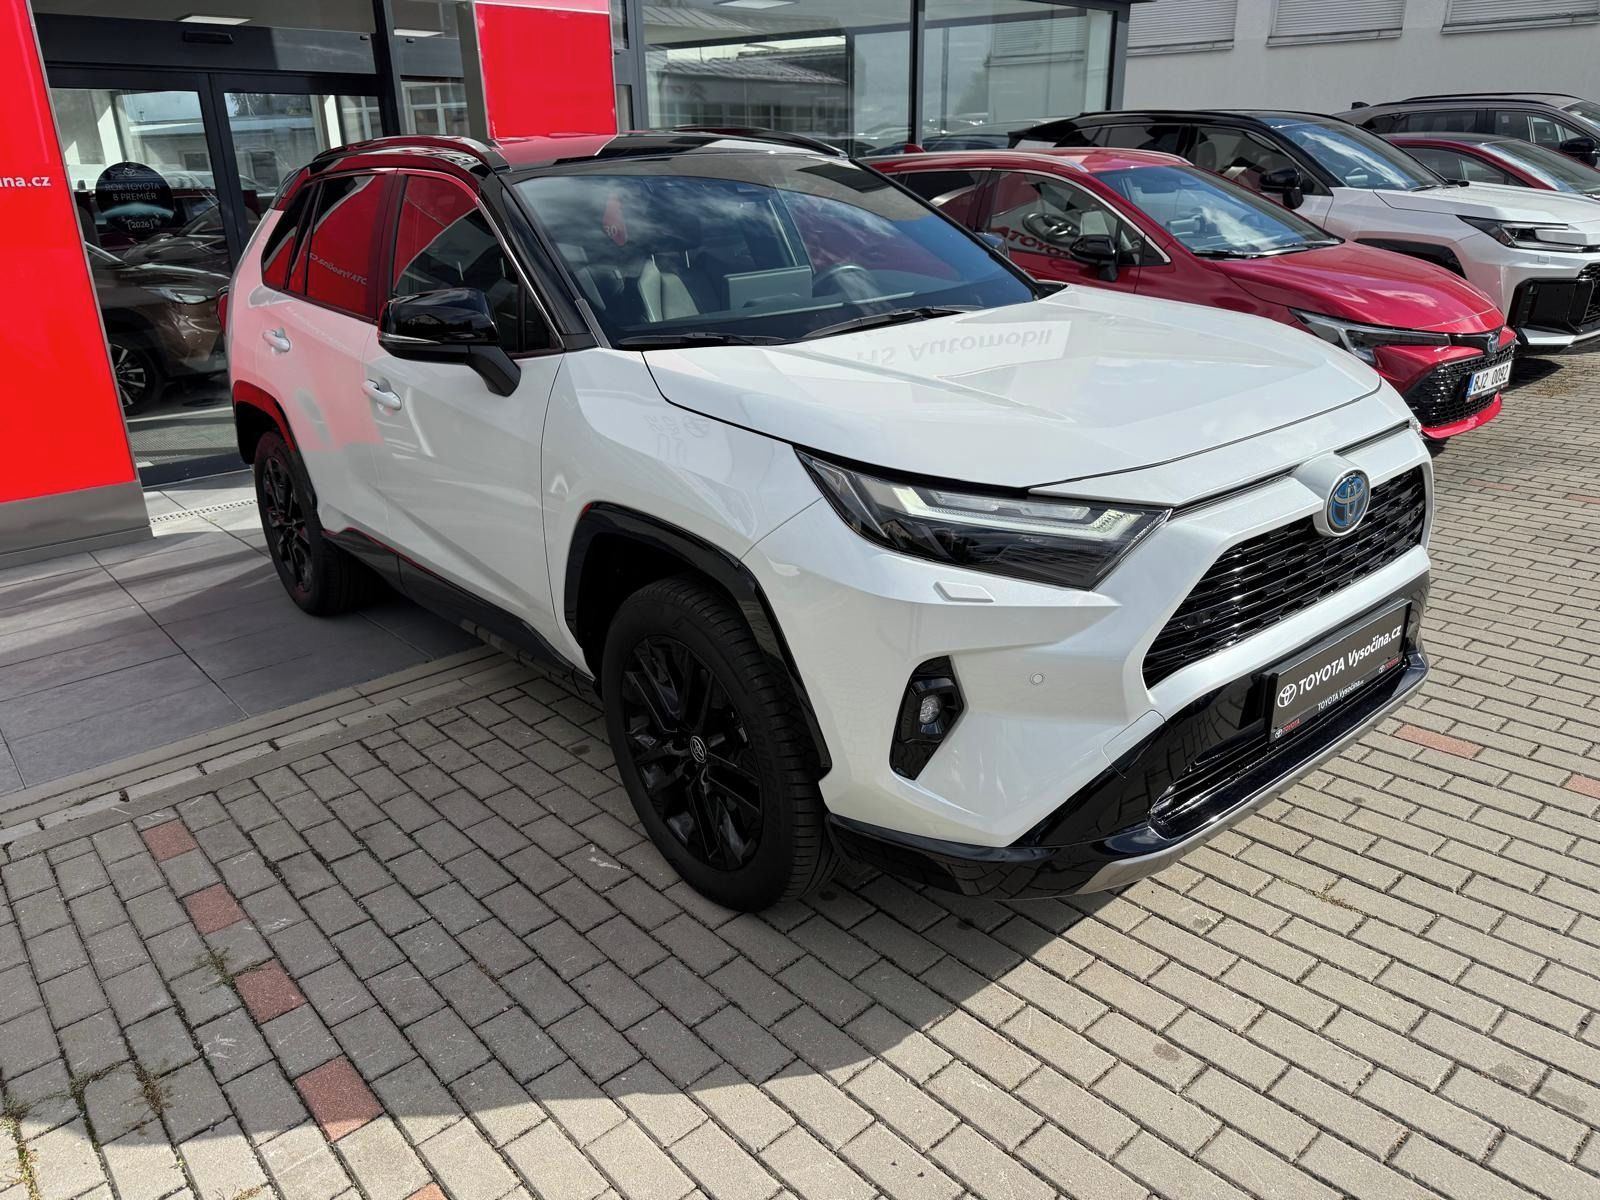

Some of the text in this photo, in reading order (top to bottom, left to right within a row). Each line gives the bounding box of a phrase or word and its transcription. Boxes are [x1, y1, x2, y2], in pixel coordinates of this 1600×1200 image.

[126, 182, 160, 191] TOYOTA
[1299, 625, 1402, 695] TOYOTA Vysočina.cz
[1317, 694, 1339, 711] TOYOTA
